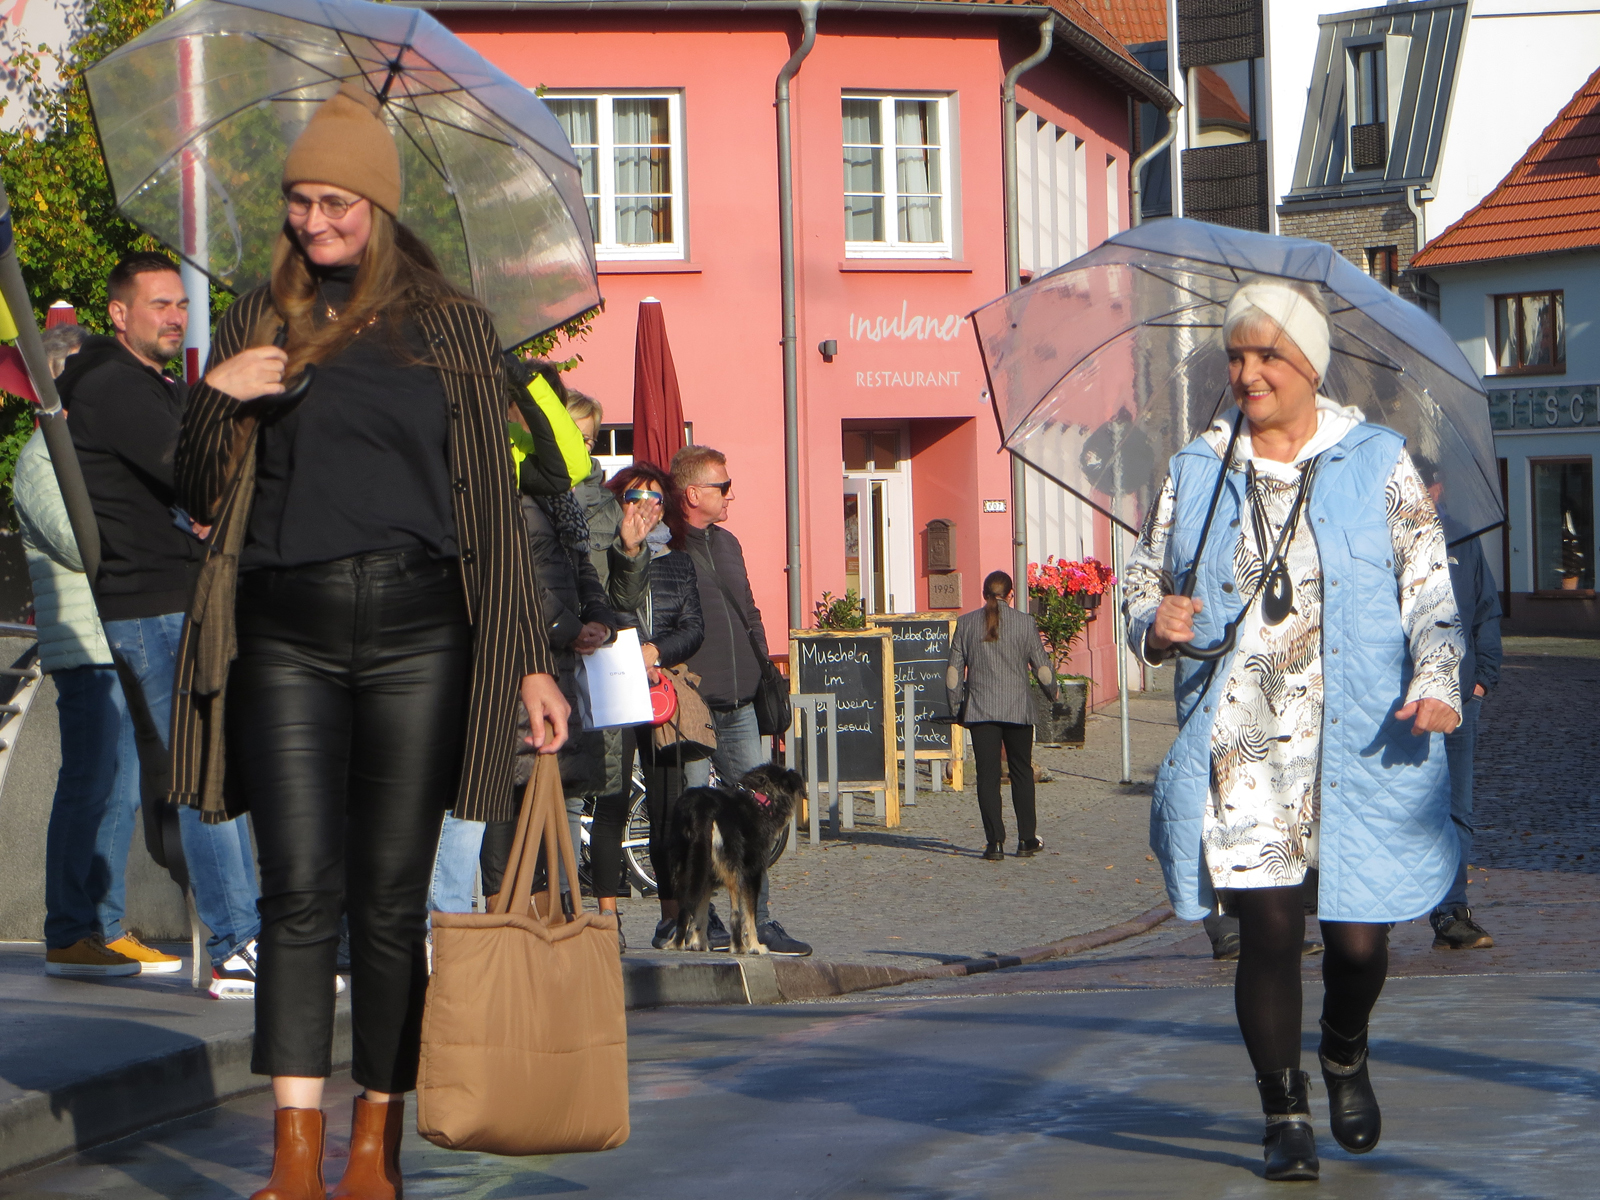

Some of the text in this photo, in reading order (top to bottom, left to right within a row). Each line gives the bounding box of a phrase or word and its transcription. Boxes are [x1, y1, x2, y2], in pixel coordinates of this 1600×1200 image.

[849, 299, 968, 342] Insulaner
[856, 371, 961, 387] RESTAURANT
[933, 584, 955, 594] 1995
[801, 642, 871, 666] Muscheln
[824, 669, 845, 687] im
[894, 666, 917, 683] elett
[894, 683, 925, 695] Duoc
